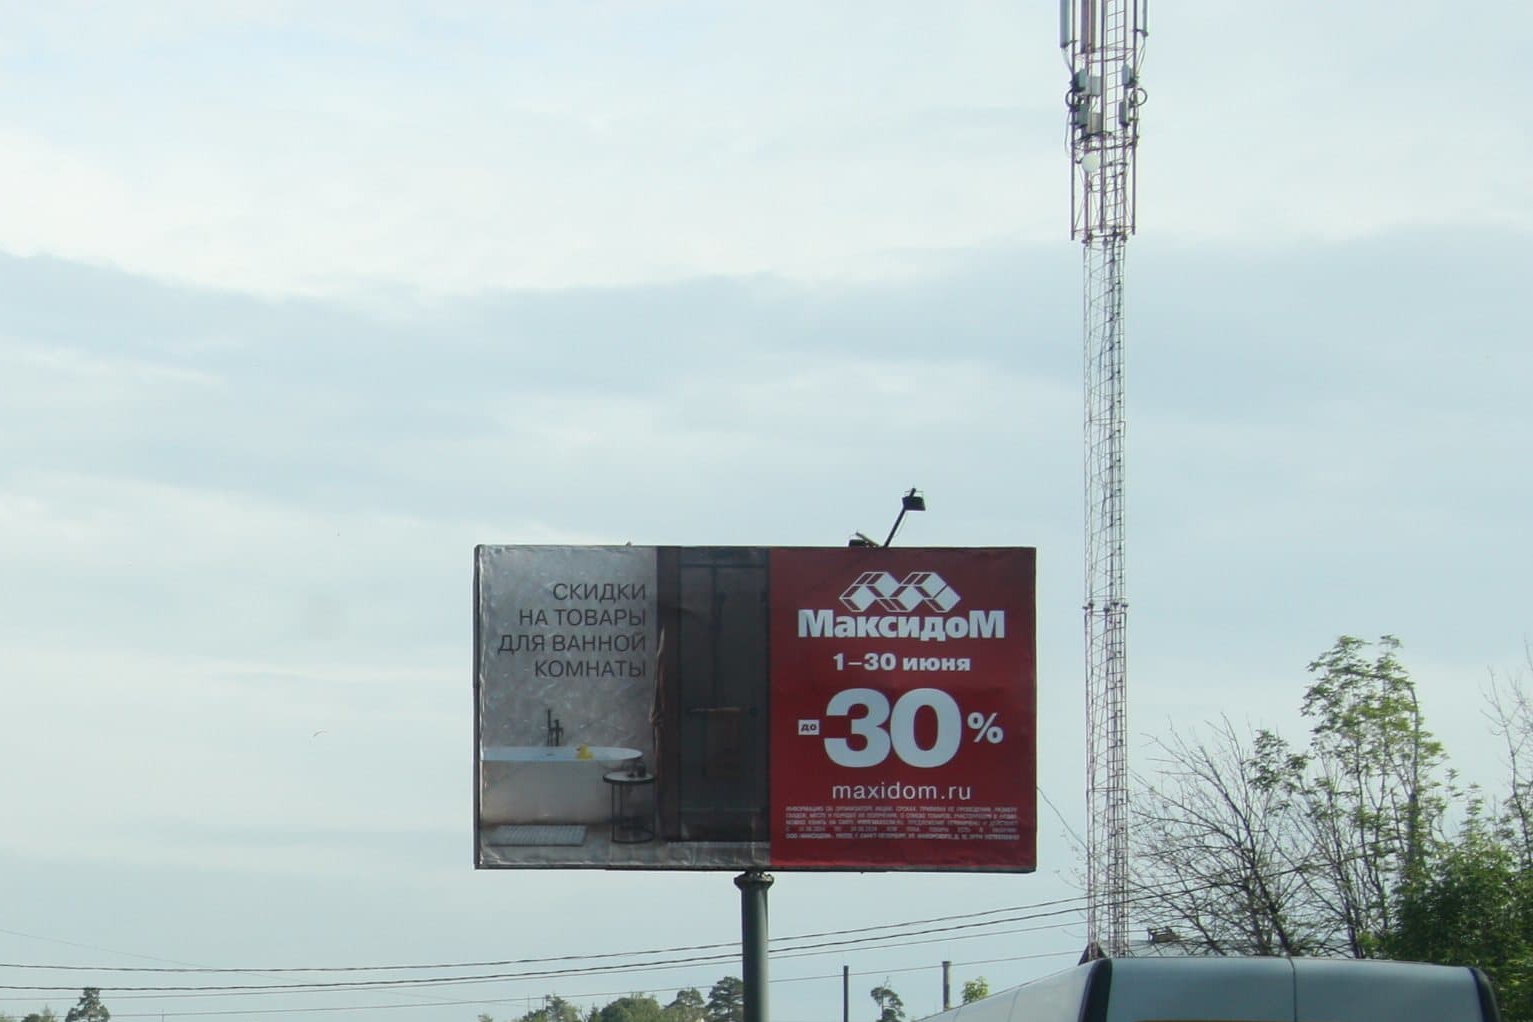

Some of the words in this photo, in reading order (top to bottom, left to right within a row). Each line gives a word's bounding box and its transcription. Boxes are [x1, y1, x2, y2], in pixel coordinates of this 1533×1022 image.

[552, 583, 646, 605] СКИДКИ
[519, 609, 548, 626] НА
[554, 609, 646, 626] ТОВАРЫ
[798, 608, 1005, 642] МаксидоМ
[497, 634, 545, 655] ДЛЯ
[552, 631, 646, 652] ВАННОЙ
[535, 660, 646, 678] КОМНАТЫ
[902, 657, 971, 671] июня
[800, 722, 818, 732] до
[832, 781, 971, 800] maxidom.ru
